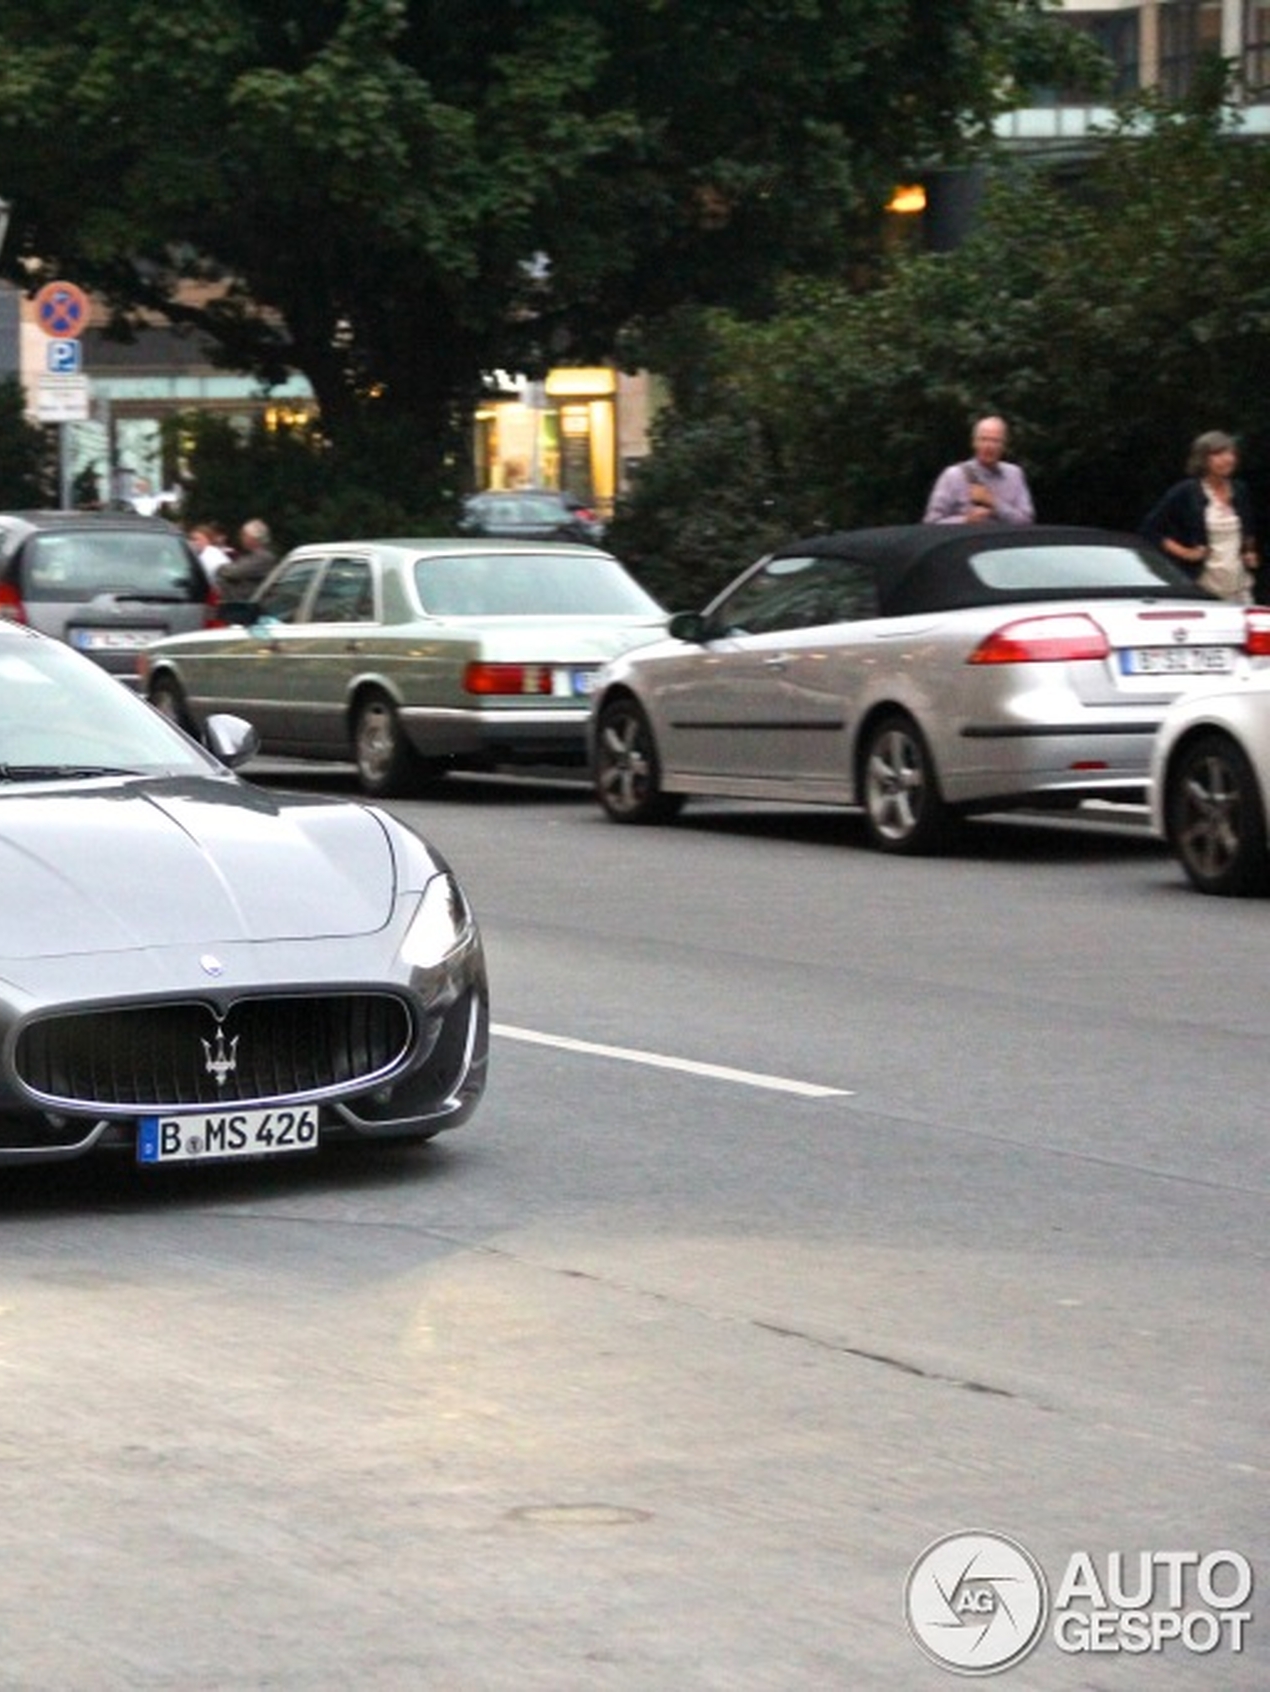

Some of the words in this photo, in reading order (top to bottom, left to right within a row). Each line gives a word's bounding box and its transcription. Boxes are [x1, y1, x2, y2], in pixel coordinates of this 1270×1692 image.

[53, 343, 73, 370] P
[161, 1122, 181, 1155] B
[205, 1116, 247, 1151] MS
[256, 1111, 316, 1146] 426
